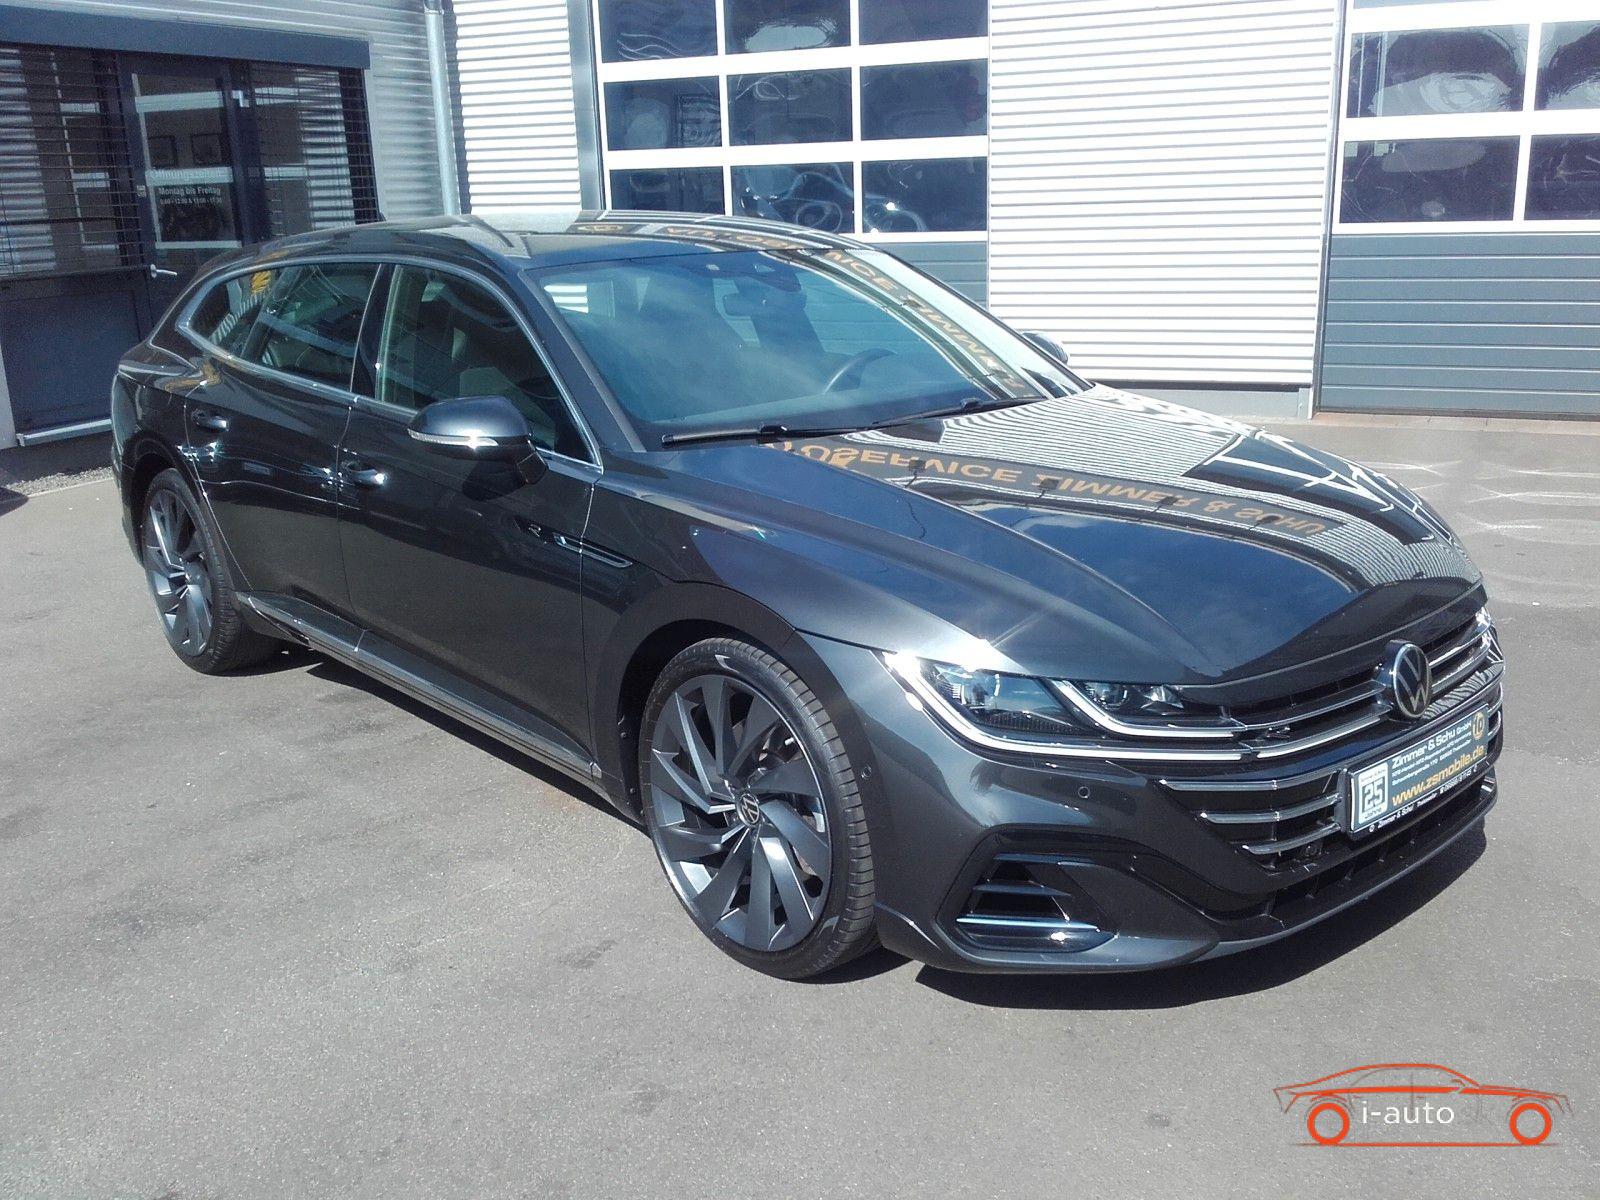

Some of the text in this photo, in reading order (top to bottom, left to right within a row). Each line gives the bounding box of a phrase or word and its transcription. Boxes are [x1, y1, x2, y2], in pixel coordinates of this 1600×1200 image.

[159, 188, 185, 197] Montag
[1392, 745, 1427, 769] Zimmer
[1427, 739, 1435, 750] &
[1436, 730, 1456, 747] Schu
[1457, 721, 1472, 734] GmbH
[1364, 777, 1383, 812] 25
[1392, 745, 1484, 806] www.zsmobile.de
